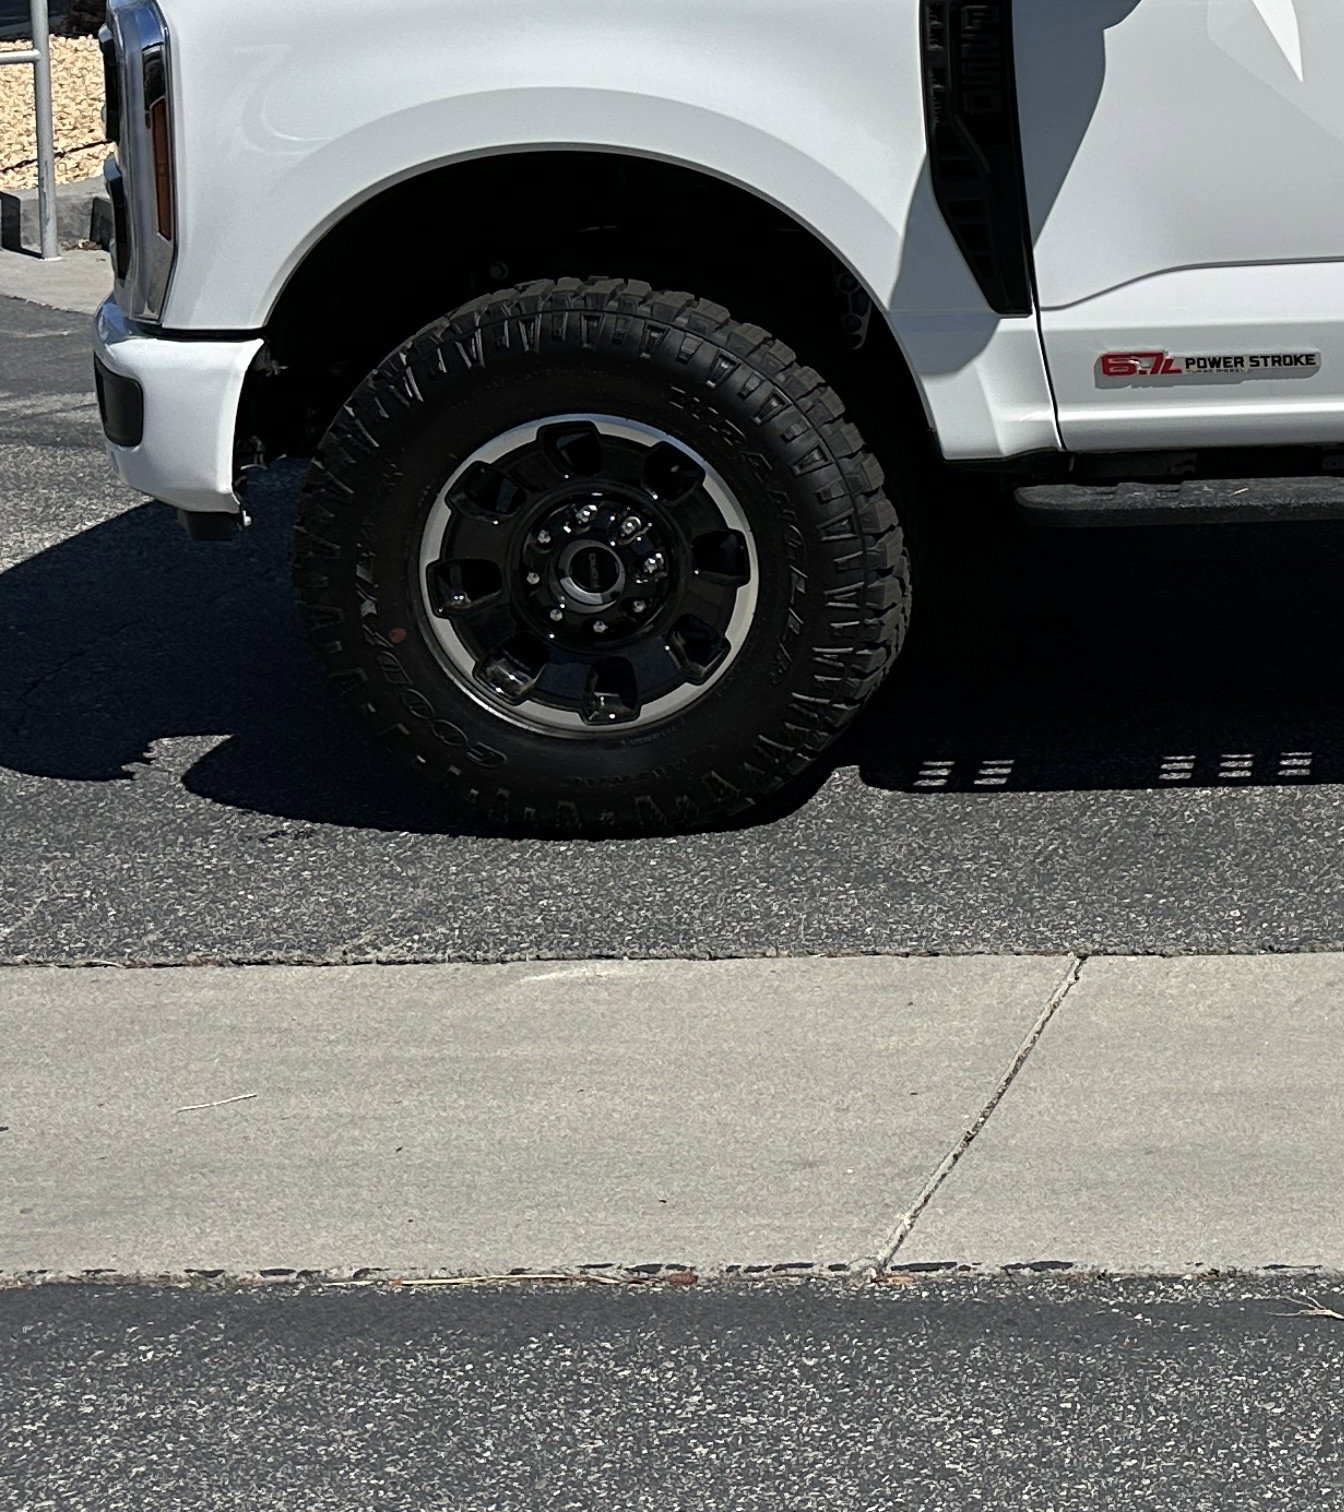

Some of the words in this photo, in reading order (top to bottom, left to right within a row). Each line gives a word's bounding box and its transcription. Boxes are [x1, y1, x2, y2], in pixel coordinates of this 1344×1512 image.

[1101, 351, 1183, 377] 6.7L
[1185, 356, 1245, 369] POWER
[1249, 353, 1317, 368] STROKE
